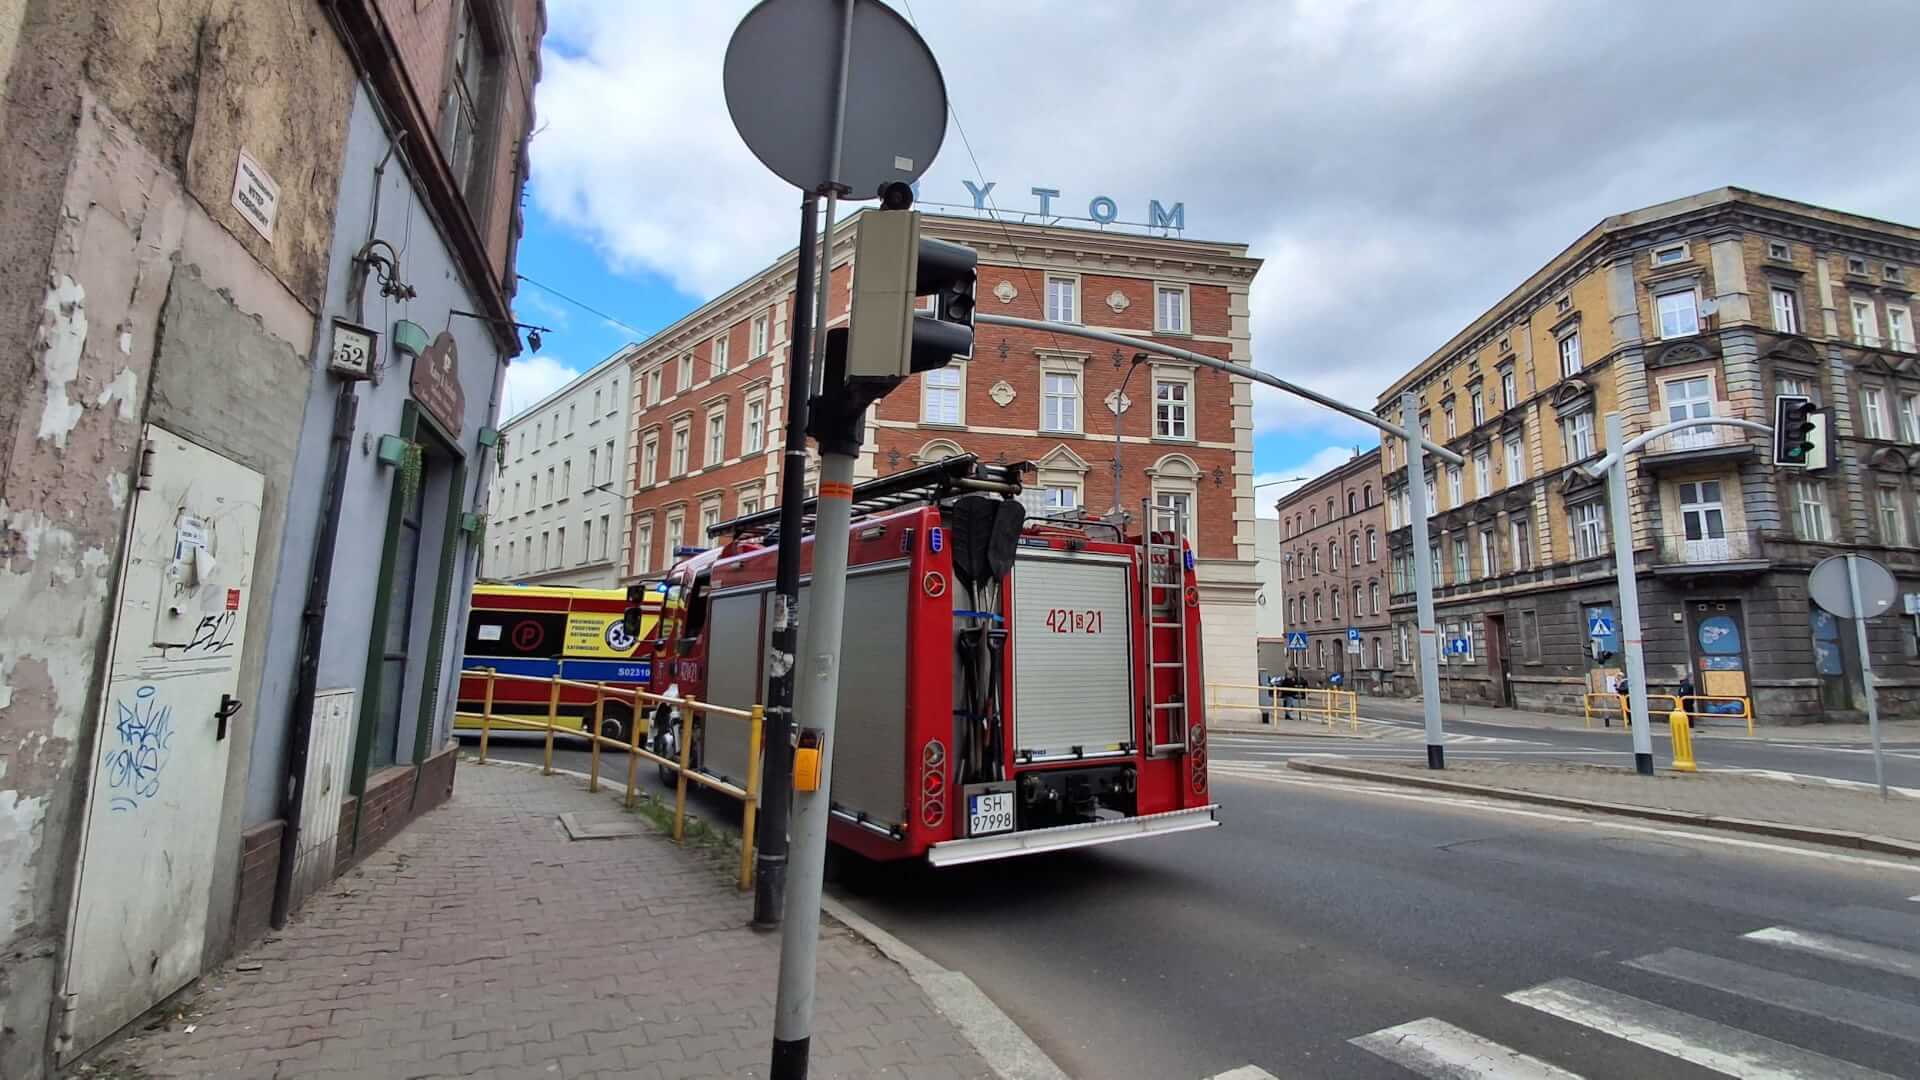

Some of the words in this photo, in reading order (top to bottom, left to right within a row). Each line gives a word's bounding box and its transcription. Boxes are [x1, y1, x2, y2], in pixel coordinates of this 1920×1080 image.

[340, 343, 364, 367] 52
[983, 797, 1002, 813] SH
[972, 813, 1011, 832] 97998
